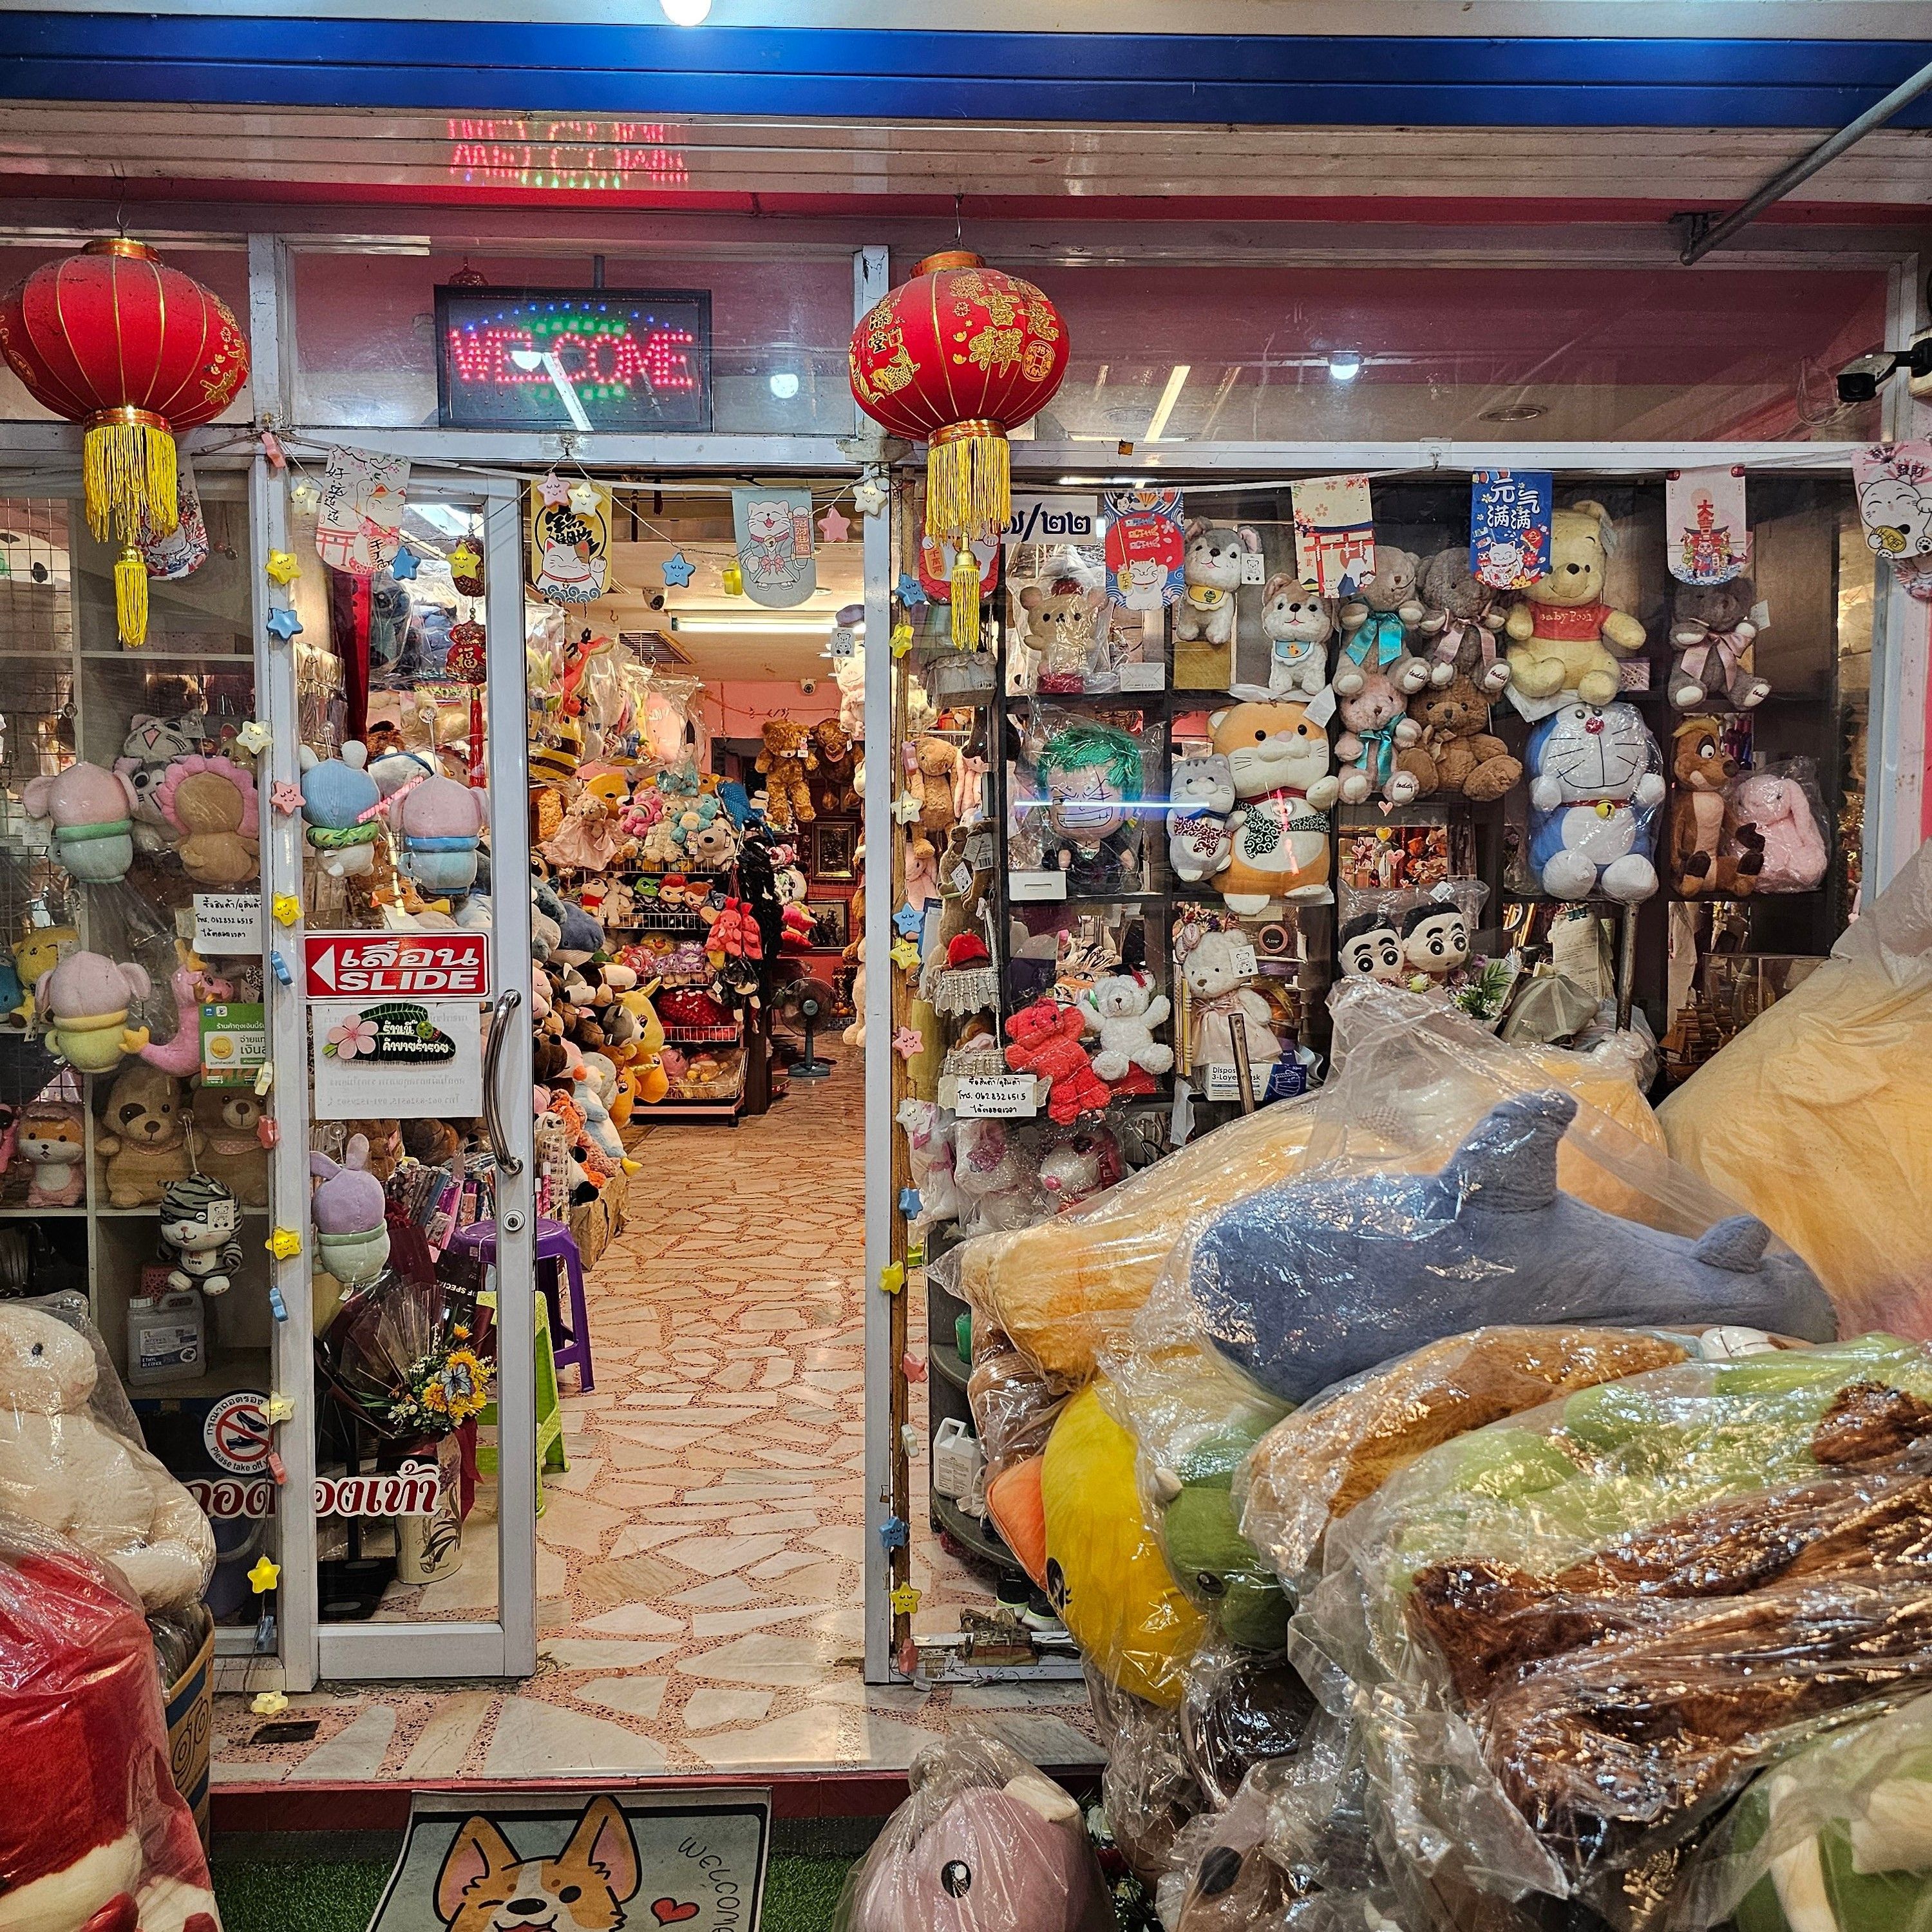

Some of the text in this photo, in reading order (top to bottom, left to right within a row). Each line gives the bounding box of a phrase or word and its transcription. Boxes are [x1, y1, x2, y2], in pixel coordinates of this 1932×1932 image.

[448, 329, 694, 387] WELCOME
[456, 647, 478, 668] 福
[1409, 670, 1426, 681] teddy
[1490, 670, 1506, 683] teddy
[1396, 781, 1413, 792] teddy
[341, 941, 480, 967] เลื่อน
[337, 970, 478, 990] SLIDE
[975, 1092, 1026, 1101] 0628326515
[211, 1446, 232, 1468] Please
[233, 1463, 251, 1472] take
[252, 1459, 263, 1469] off
